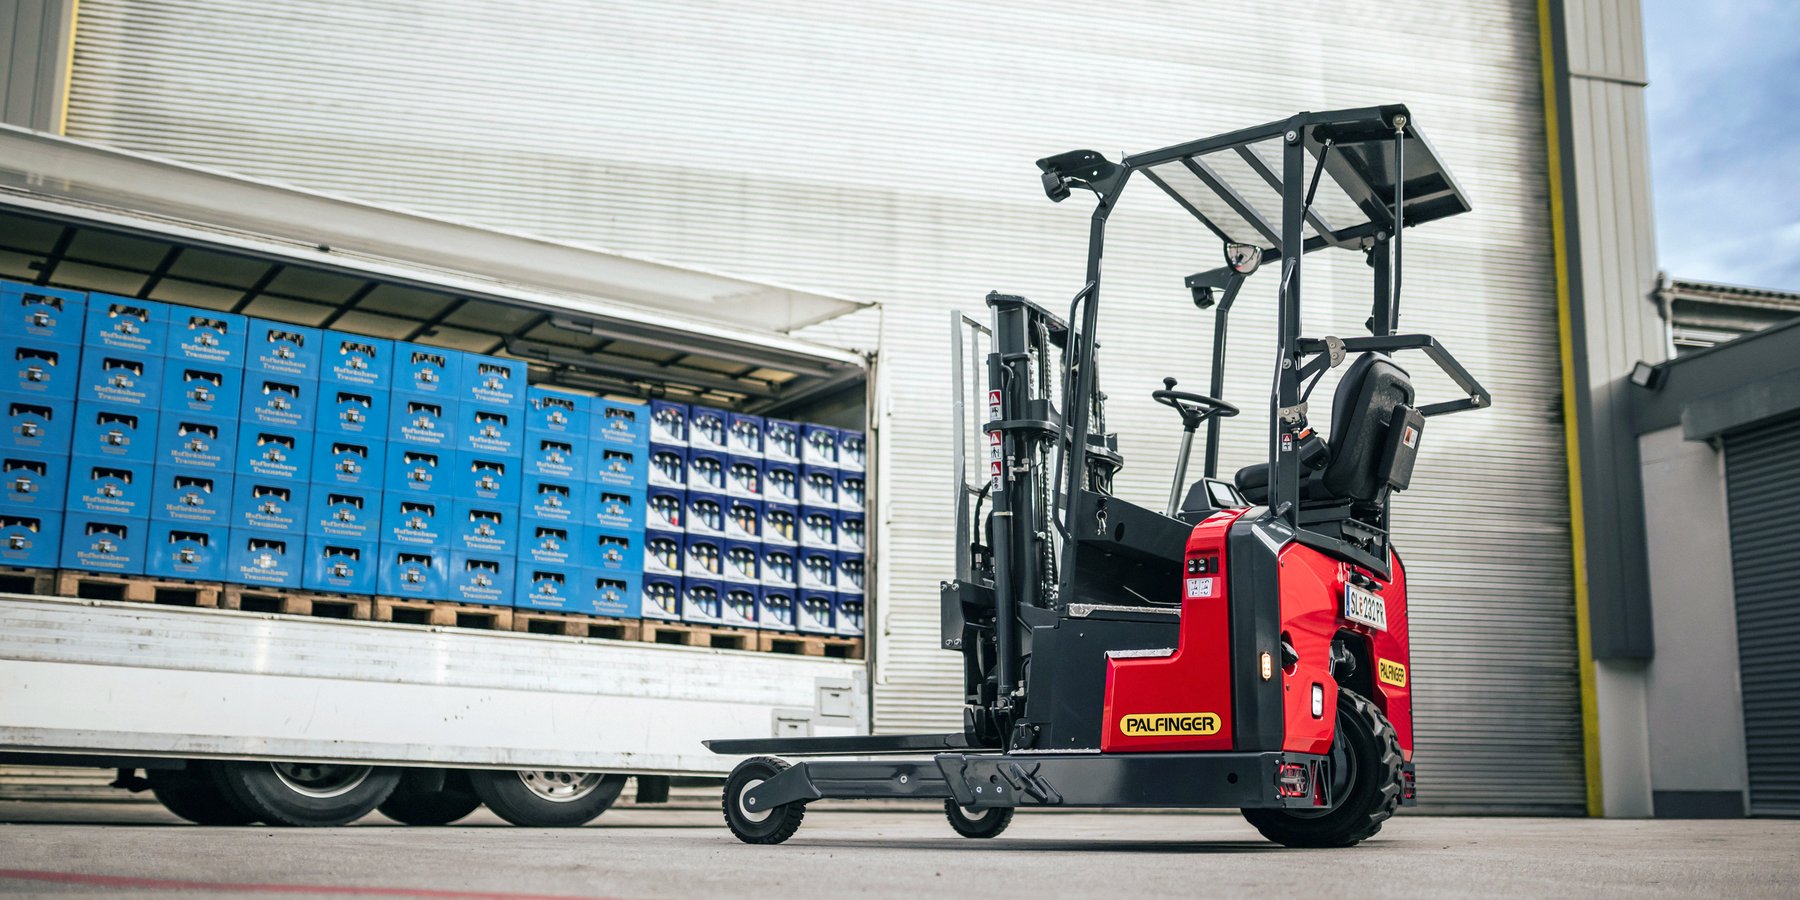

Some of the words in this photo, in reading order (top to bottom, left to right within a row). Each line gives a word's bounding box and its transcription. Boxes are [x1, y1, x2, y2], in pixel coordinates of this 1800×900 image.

[1351, 592, 1360, 615] SL
[1380, 662, 1404, 683] PALFINGER
[1127, 717, 1214, 732] PALFINGER
